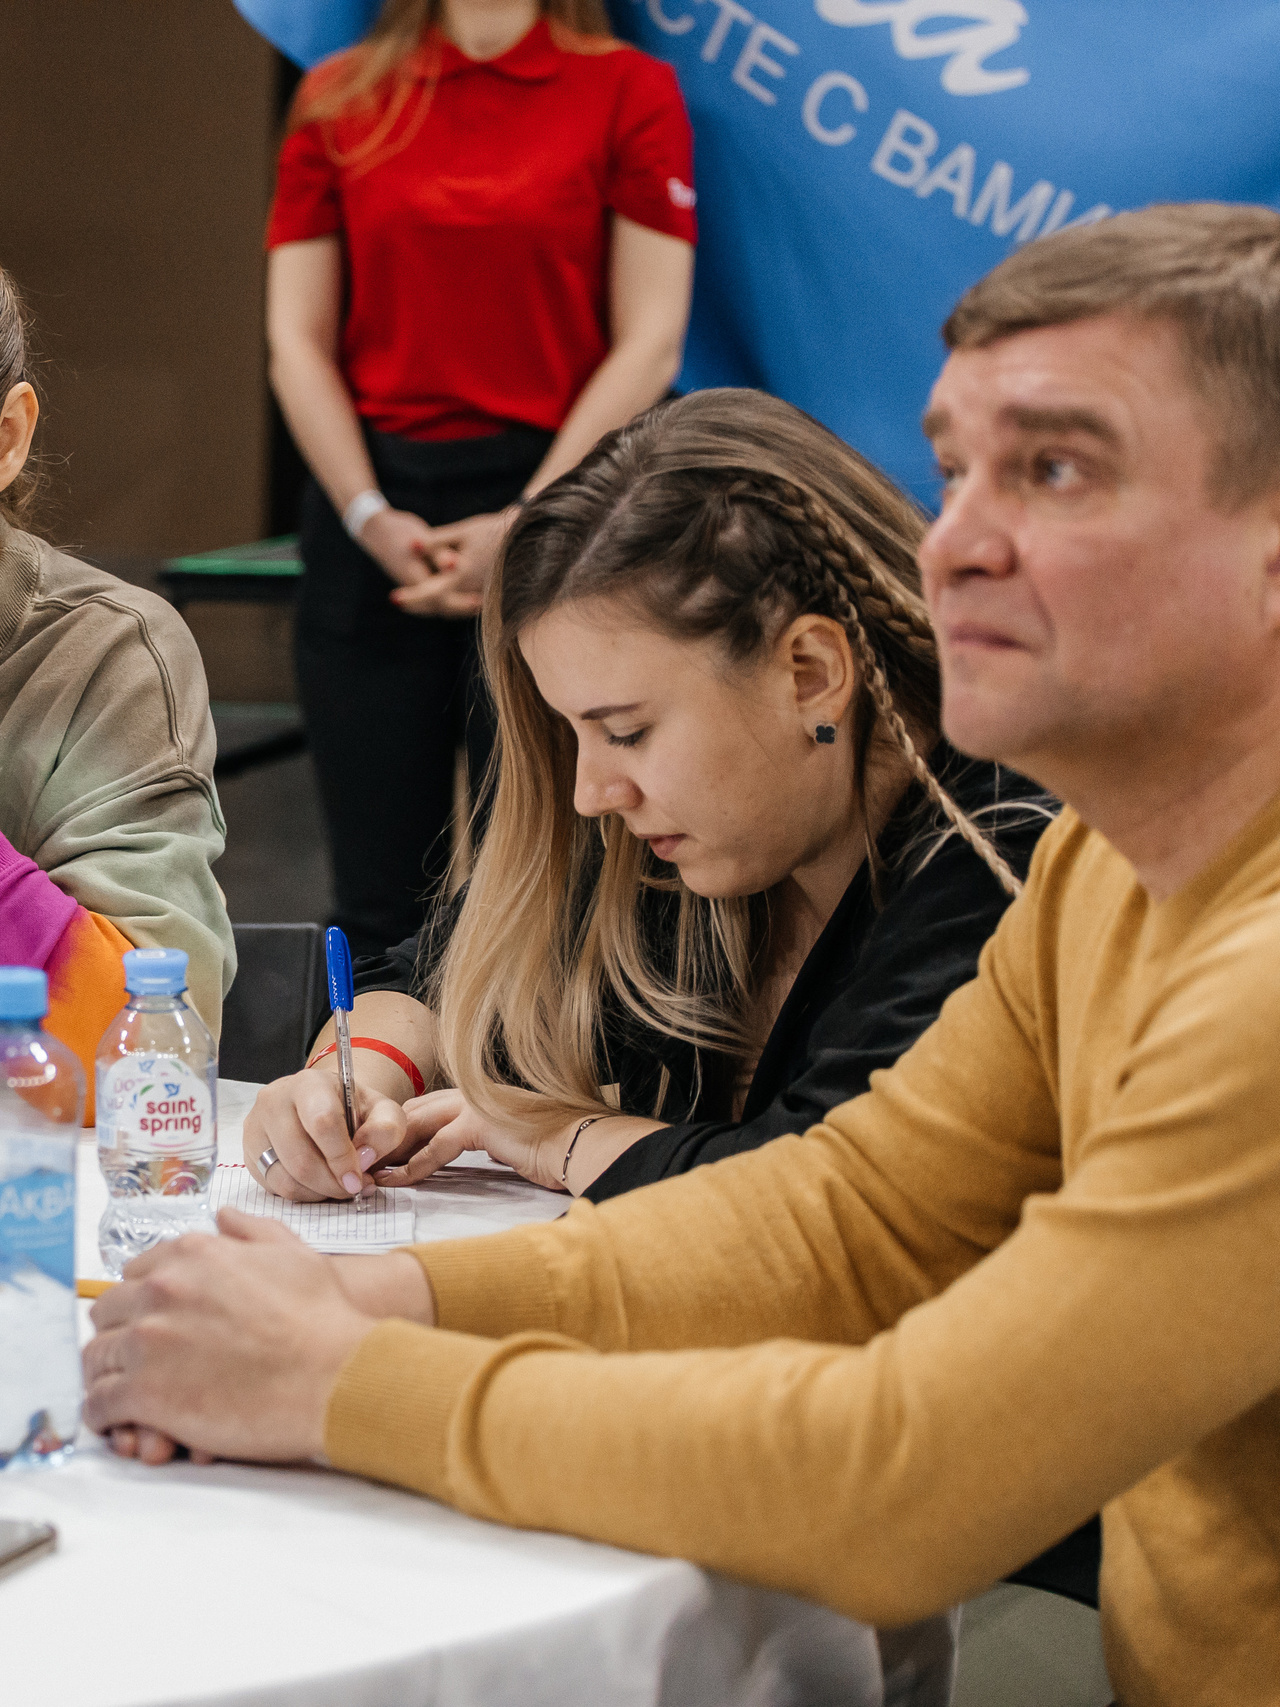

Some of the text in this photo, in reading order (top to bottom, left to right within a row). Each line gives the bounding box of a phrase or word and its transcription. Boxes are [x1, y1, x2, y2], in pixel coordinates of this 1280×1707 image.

[802, 70, 869, 146] С
[146, 1096, 197, 1115] saint
[139, 1115, 202, 1137] spring
